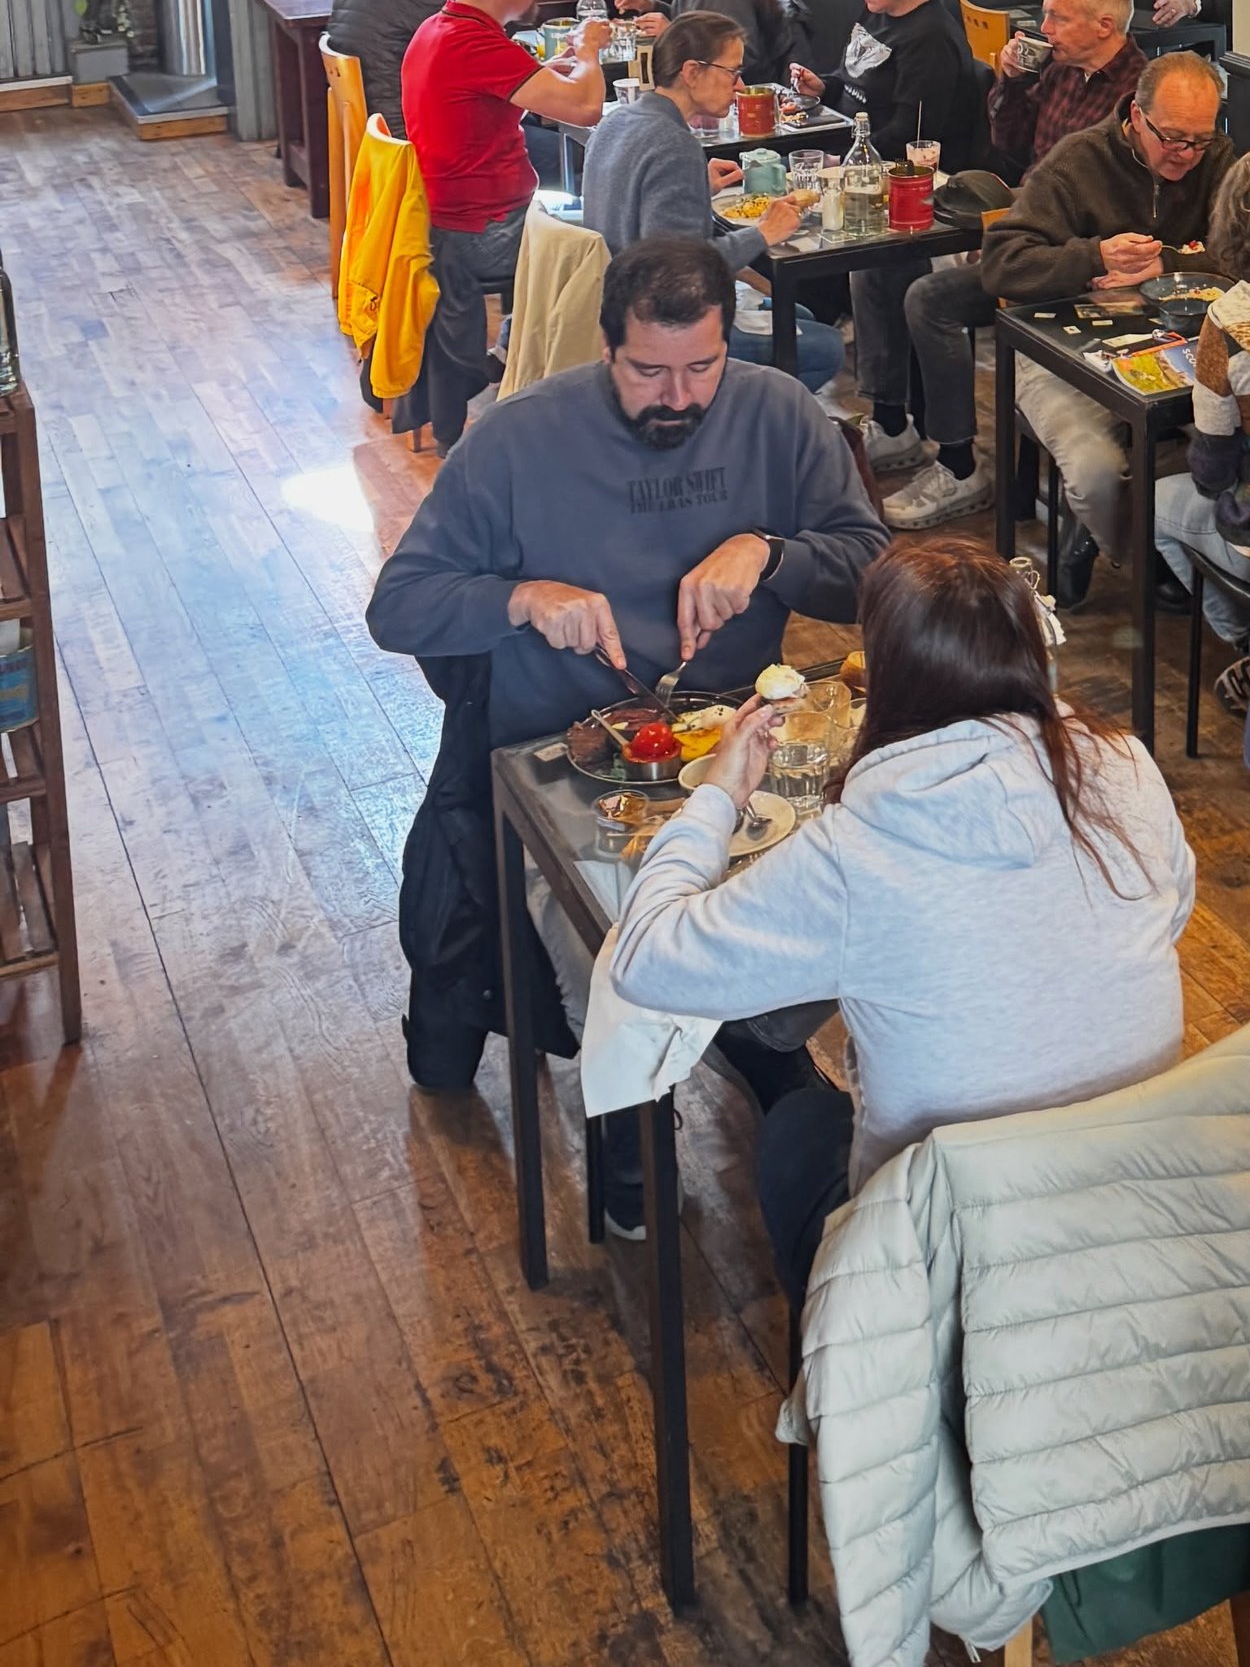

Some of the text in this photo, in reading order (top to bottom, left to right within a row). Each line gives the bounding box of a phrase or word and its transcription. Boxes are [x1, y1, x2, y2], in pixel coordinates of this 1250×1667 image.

[627, 466, 727, 504] TAYLOR SWIFT
[696, 489, 728, 506] TOUR
